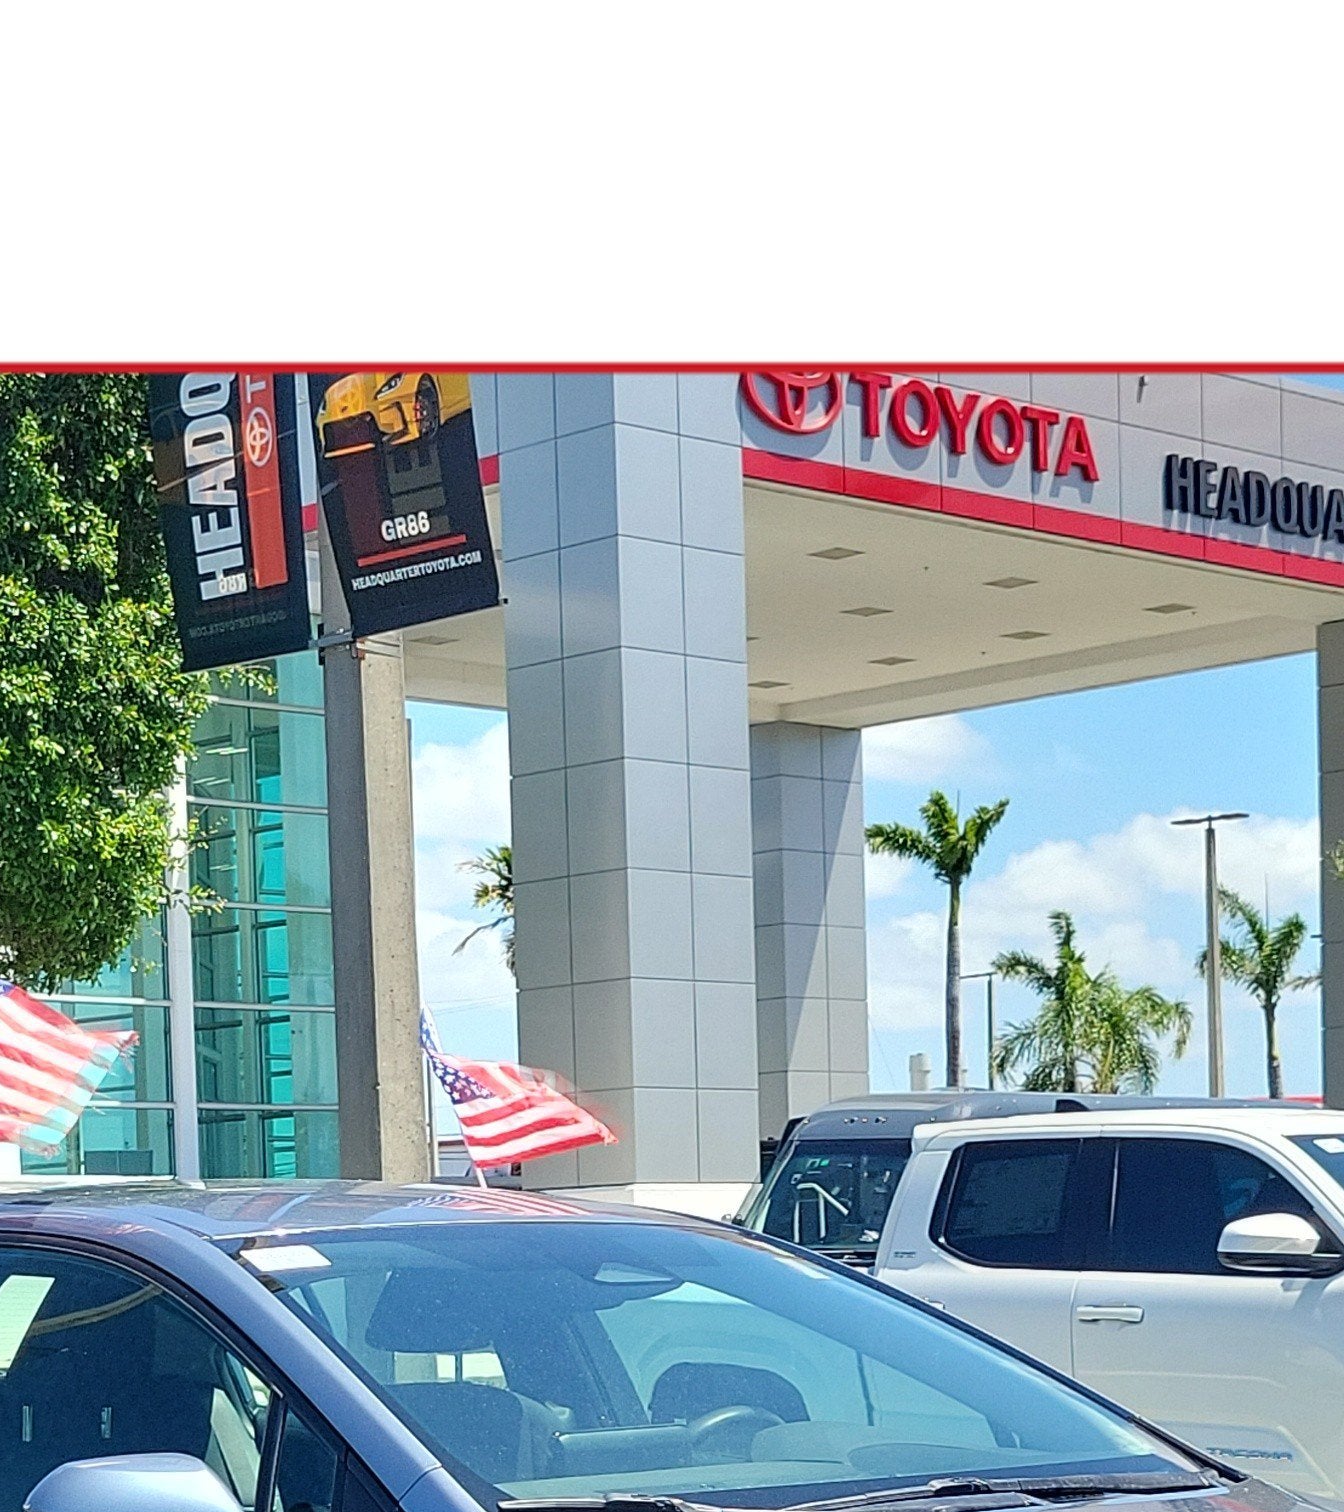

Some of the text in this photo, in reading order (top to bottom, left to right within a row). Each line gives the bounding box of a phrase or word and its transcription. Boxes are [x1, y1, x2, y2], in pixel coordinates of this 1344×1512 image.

[848, 373, 1100, 482] TOYOTA
[381, 510, 431, 542] GR86
[351, 550, 483, 591] HEADQUARTERTOYOTA.COM
